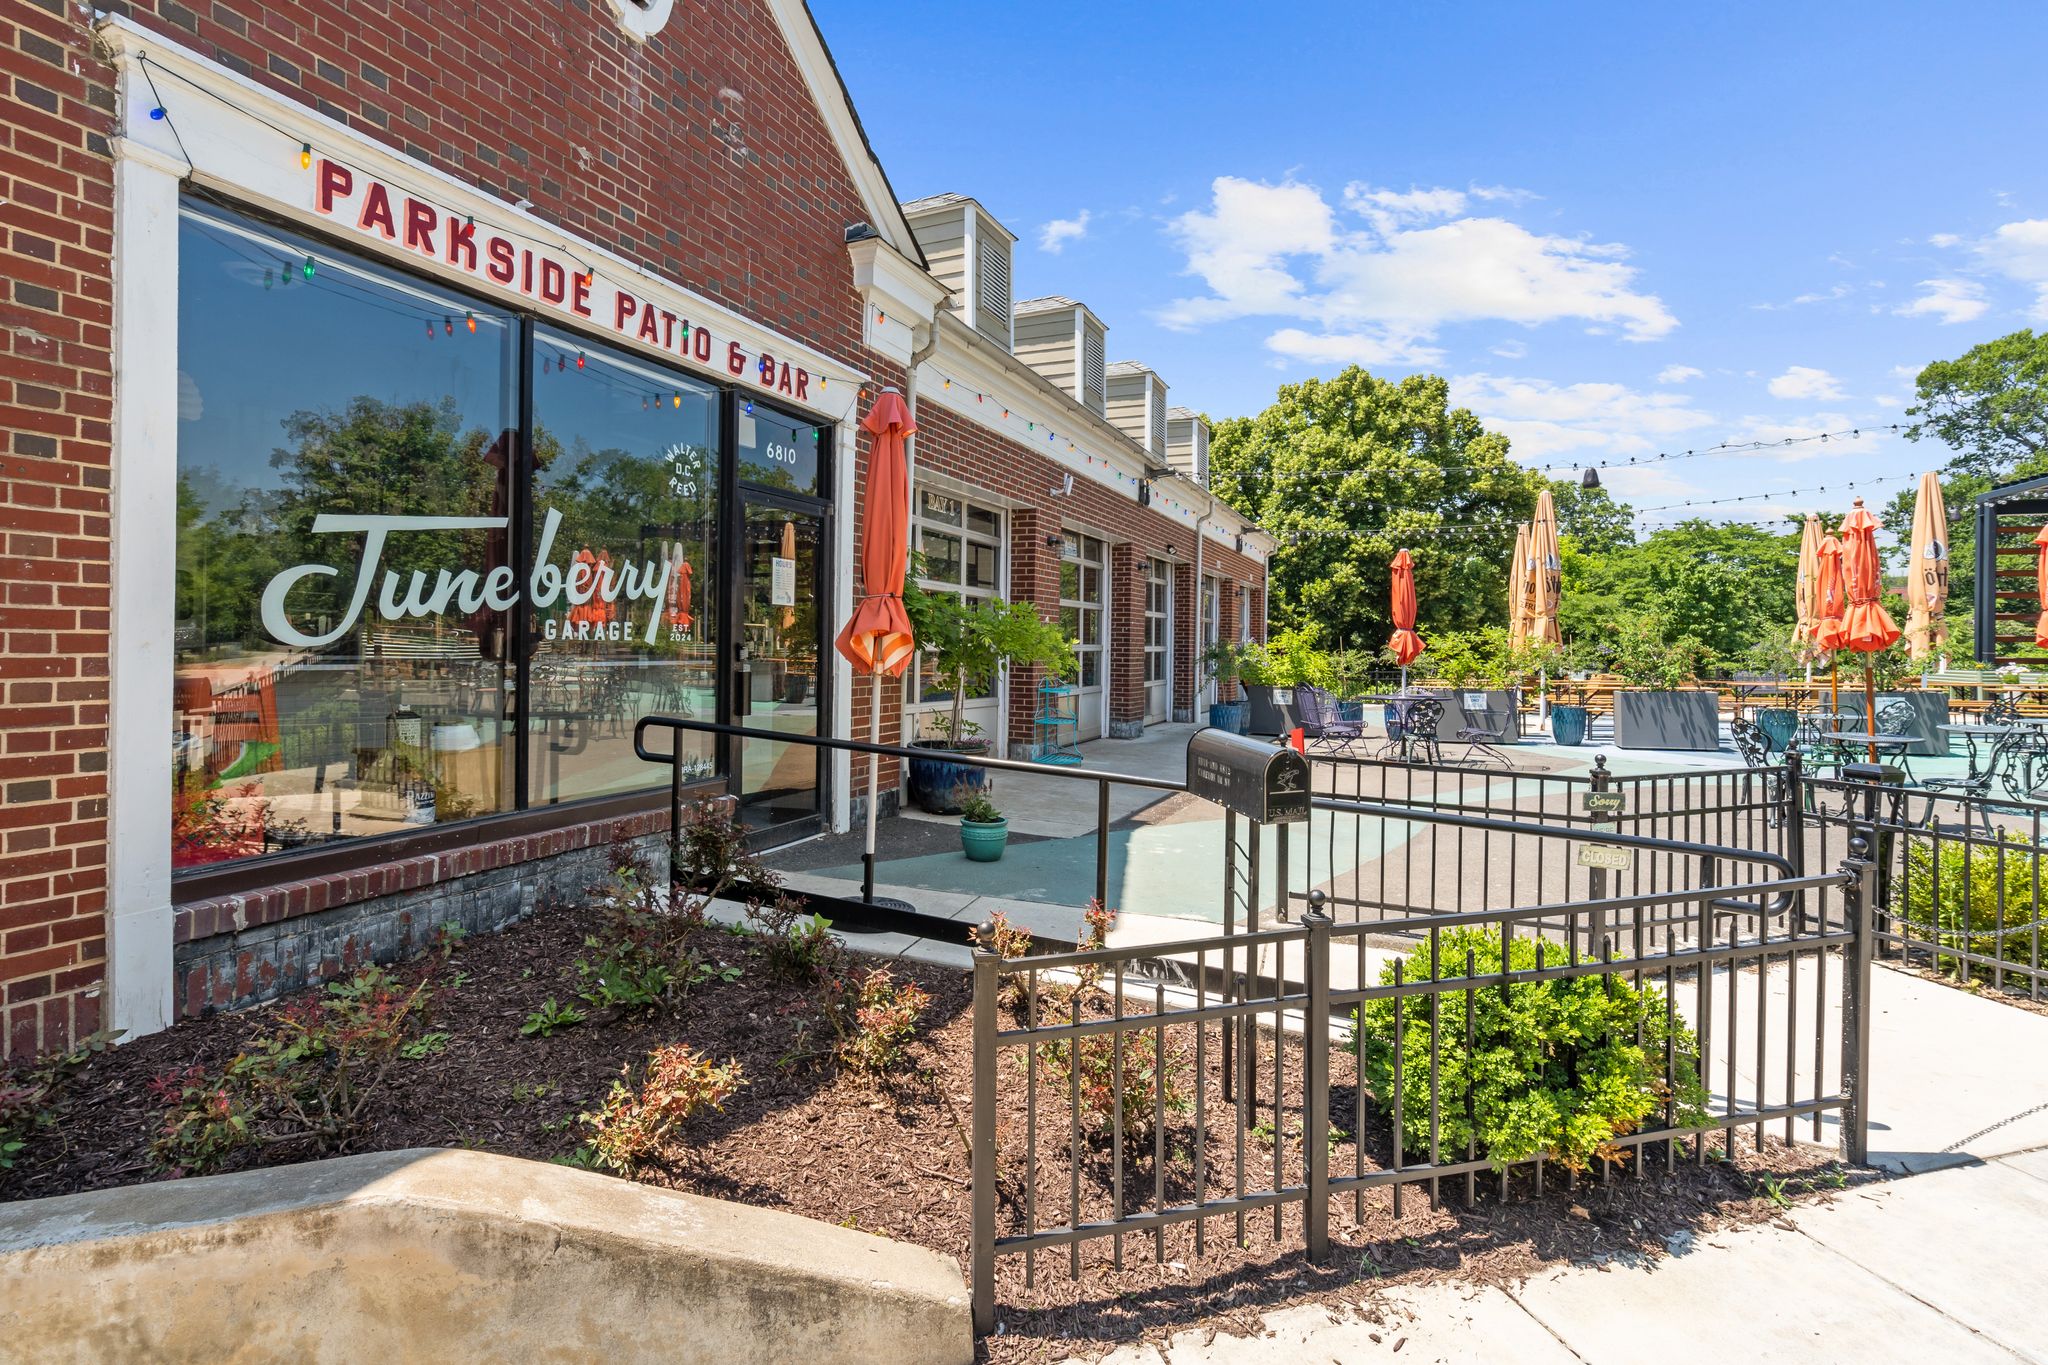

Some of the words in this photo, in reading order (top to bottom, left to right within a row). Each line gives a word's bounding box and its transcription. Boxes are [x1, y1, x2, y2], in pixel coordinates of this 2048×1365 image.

[315, 157, 593, 318] PARKSIDE
[614, 290, 712, 367] PATIO
[726, 341, 747, 375] &
[757, 352, 809, 401] BAR
[665, 442, 701, 469] WALTER
[766, 441, 796, 464] 6810
[675, 462, 693, 477] D.C.
[668, 476, 697, 496] REED
[260, 507, 673, 648] Juneberry
[544, 619, 633, 641] GARAGE
[670, 633, 692, 642] 2024
[672, 623, 691, 632] EST.
[1589, 794, 1620, 811] Sorry
[1582, 850, 1627, 866] CLOSED
